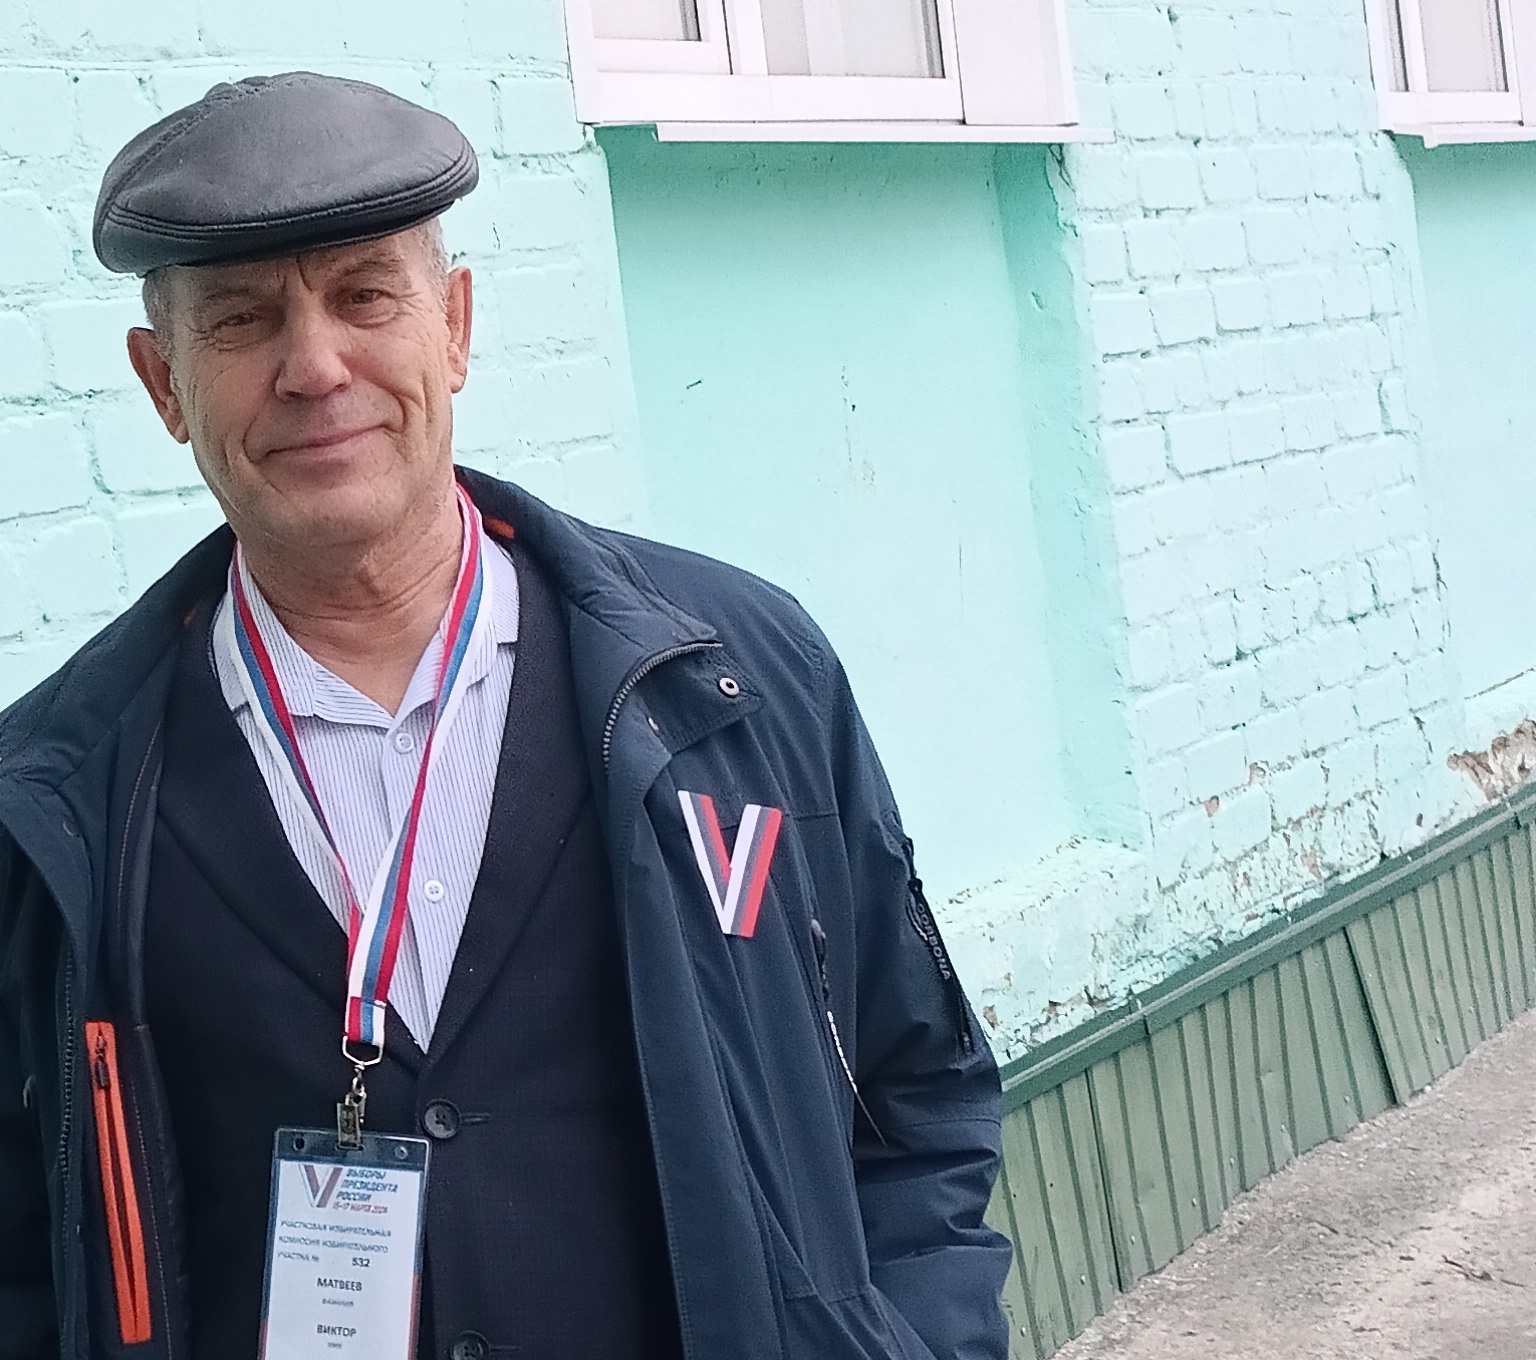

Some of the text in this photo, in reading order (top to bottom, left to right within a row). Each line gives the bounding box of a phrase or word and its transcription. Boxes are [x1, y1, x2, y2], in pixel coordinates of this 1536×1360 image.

[352, 1257, 371, 1268] 532
[317, 1277, 363, 1291] МАТВЕЕВ
[317, 1324, 357, 1337] ВИКТОР
